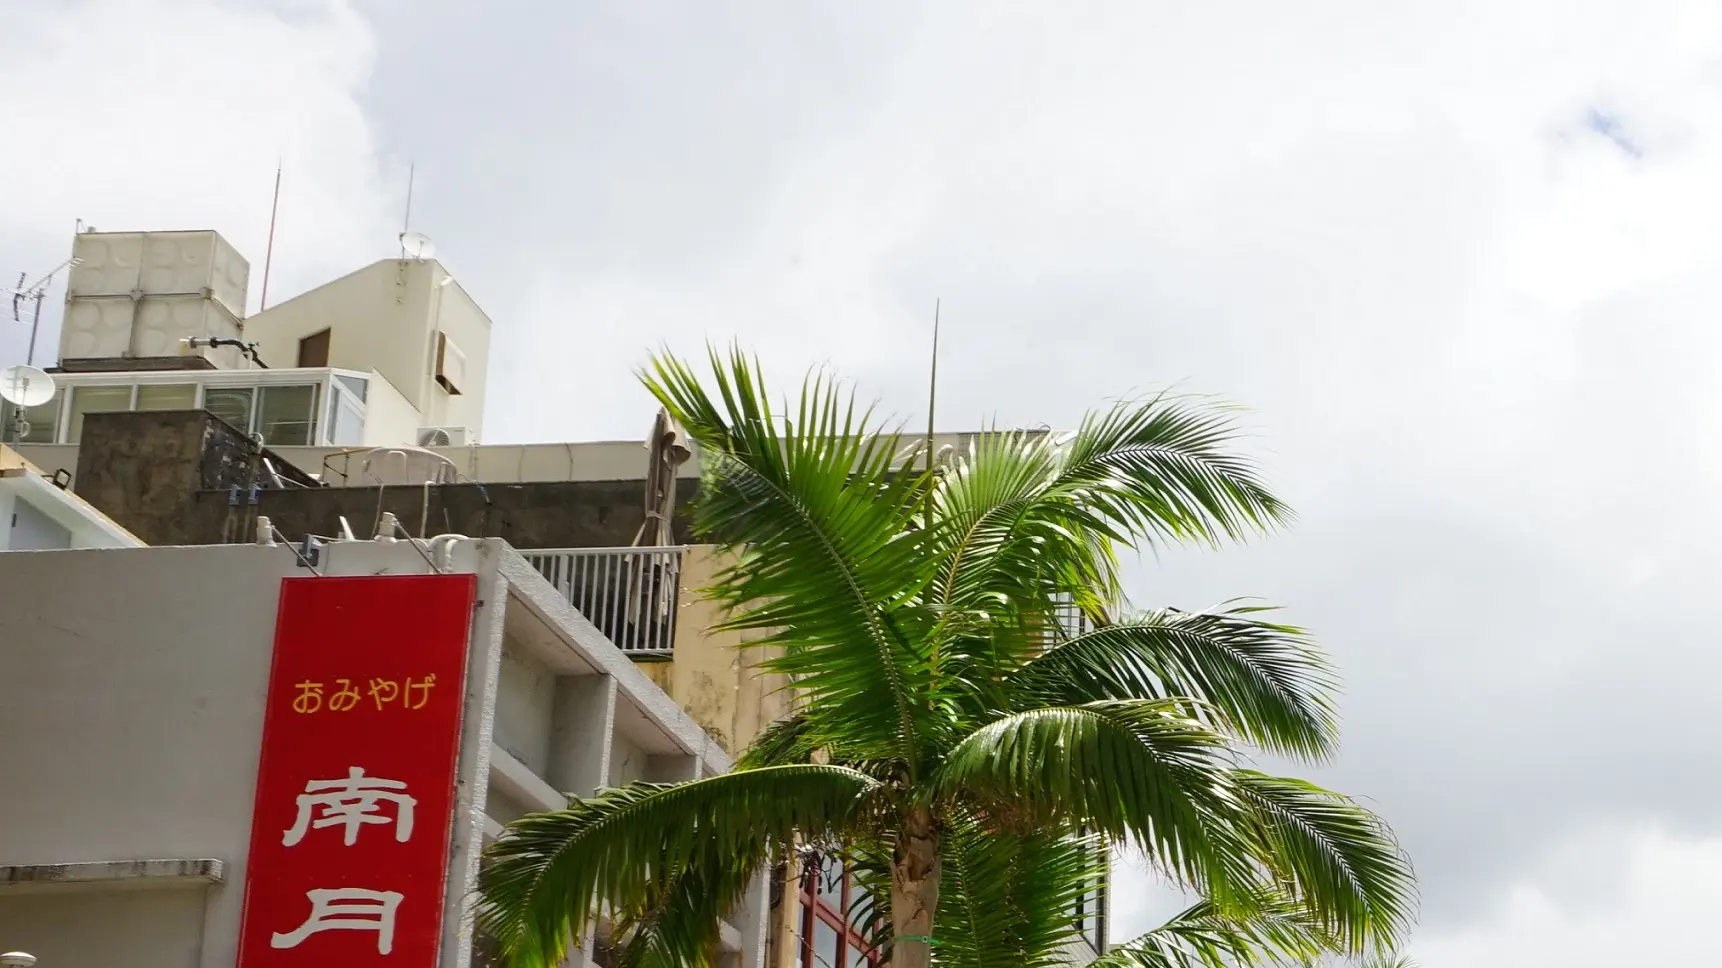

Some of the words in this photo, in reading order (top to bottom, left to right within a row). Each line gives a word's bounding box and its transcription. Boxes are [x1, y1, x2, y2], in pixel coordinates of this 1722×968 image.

[292, 673, 437, 714] おみやげ
[270, 765, 418, 956] 南月
